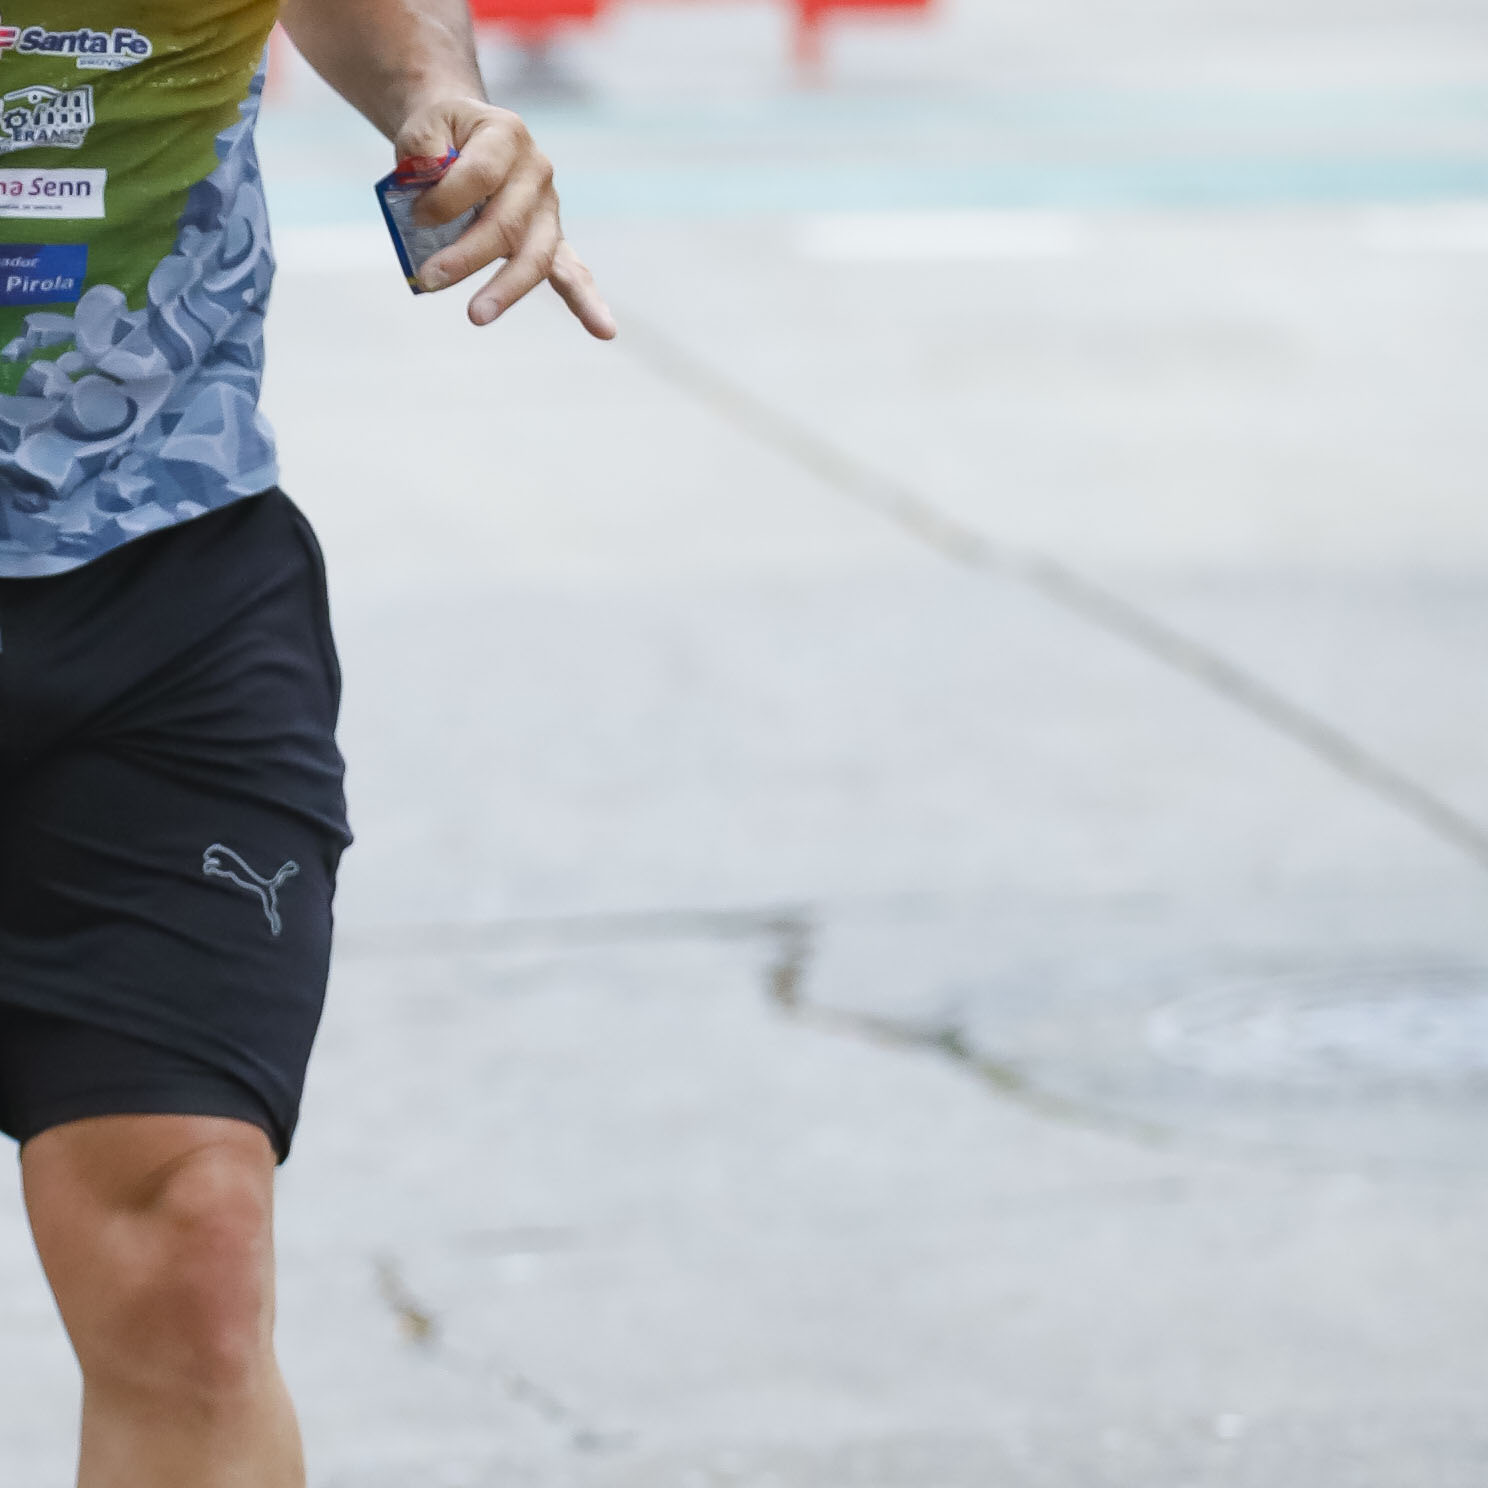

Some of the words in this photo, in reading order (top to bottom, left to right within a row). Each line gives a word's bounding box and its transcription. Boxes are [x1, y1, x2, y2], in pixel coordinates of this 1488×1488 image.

[20, 29, 108, 53] Santa
[114, 31, 148, 55] Fe
[28, 177, 91, 197] Senn
[6, 275, 75, 293] Pirola
